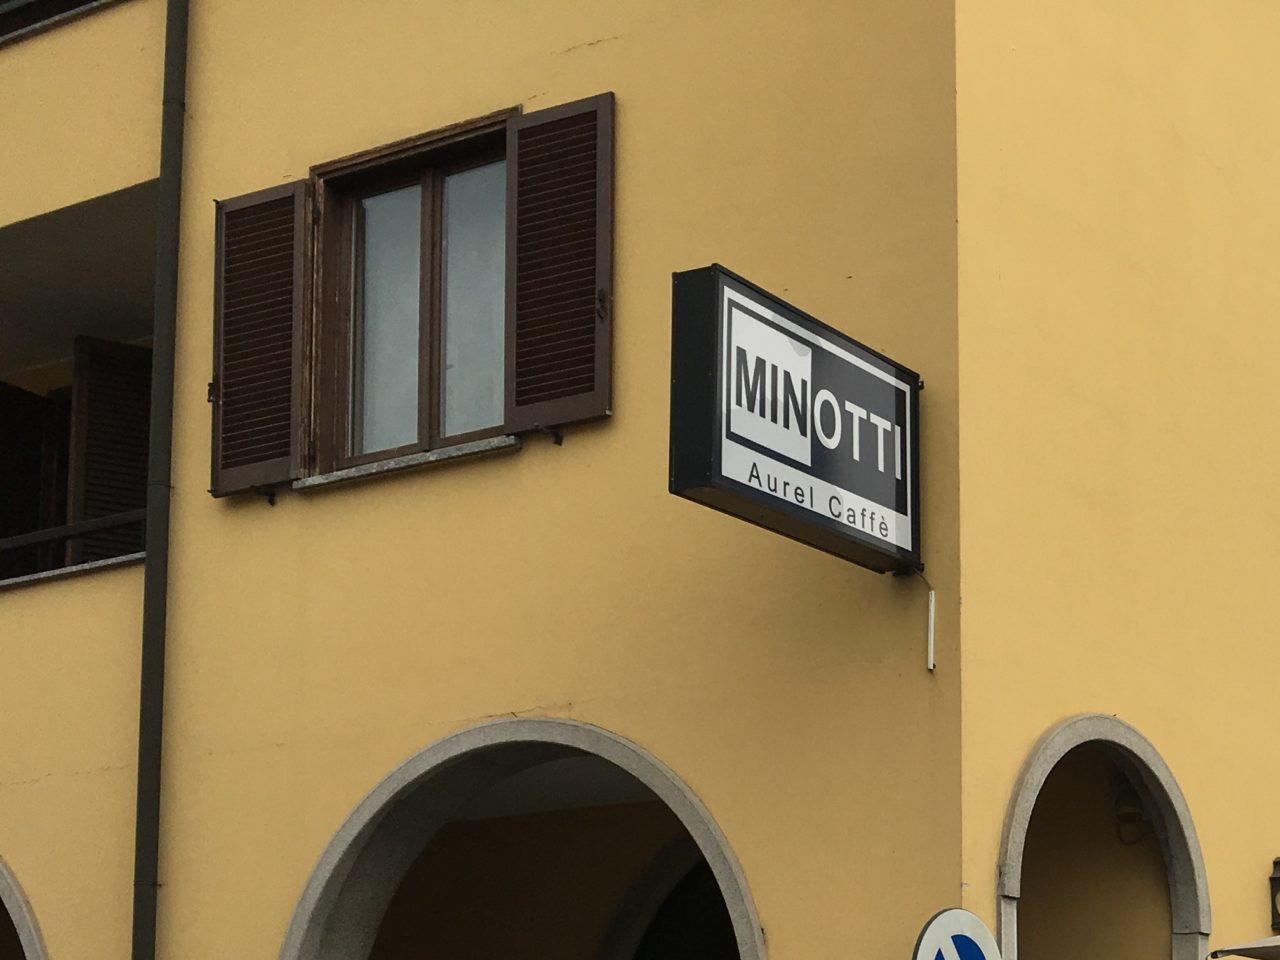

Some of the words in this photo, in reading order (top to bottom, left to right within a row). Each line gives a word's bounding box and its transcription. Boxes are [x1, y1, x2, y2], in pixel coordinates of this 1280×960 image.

[735, 345, 902, 481] MINOTTI
[748, 462, 814, 508] Aurel
[828, 495, 889, 538] Caffè
